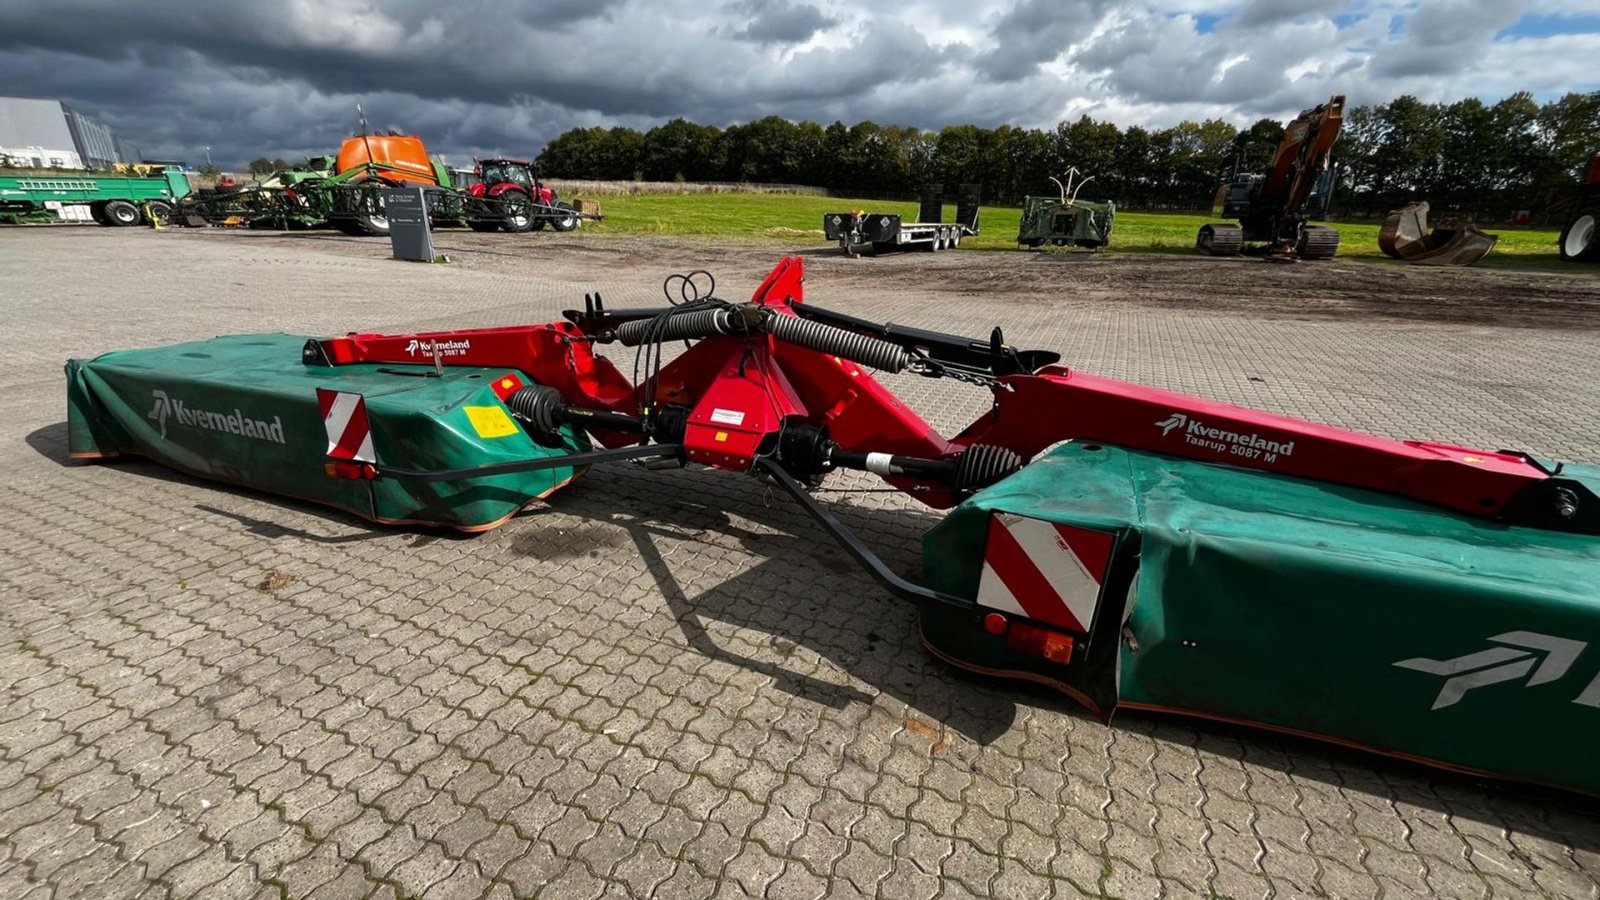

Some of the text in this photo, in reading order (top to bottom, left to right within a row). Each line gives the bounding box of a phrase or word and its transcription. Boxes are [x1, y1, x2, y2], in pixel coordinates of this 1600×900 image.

[420, 339, 470, 350] Kvrneland
[172, 398, 286, 444] Kverneland
[1185, 433, 1277, 464] Taarup 5087 M
[1187, 420, 1295, 456] Kverneland
